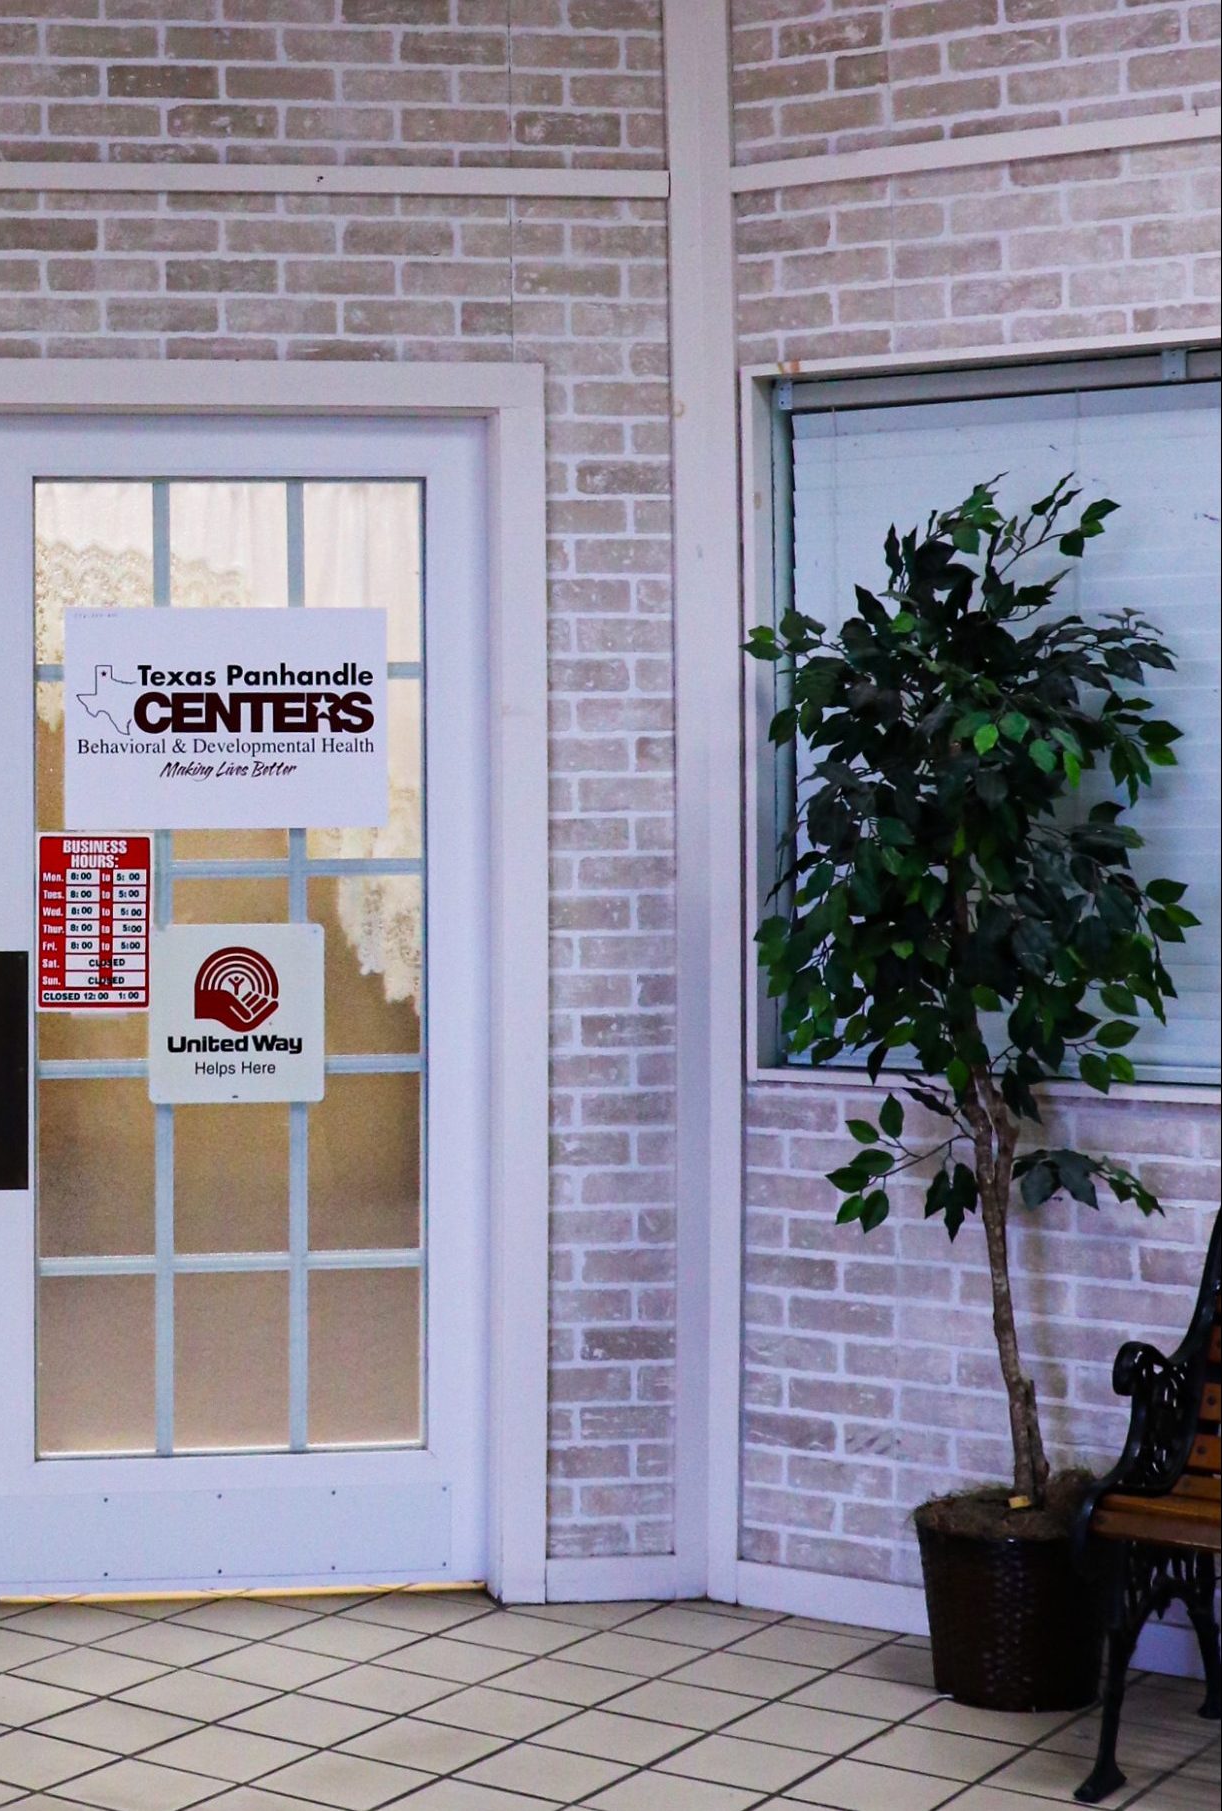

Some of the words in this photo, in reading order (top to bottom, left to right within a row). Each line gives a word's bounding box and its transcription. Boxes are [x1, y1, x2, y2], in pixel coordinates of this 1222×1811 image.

[137, 665, 216, 686] Texas
[227, 663, 374, 686] Panhandle
[134, 691, 375, 734] CENTERS
[78, 739, 166, 754] Behavioral
[172, 739, 187, 754] &
[193, 738, 315, 757] Developmental
[321, 738, 374, 753] Health
[160, 761, 214, 782] Making
[216, 762, 248, 777] Lives
[251, 761, 297, 777] Better
[63, 840, 127, 854] BUSINESS
[71, 855, 119, 868] HOURS:
[43, 873, 64, 882] Mon.
[101, 873, 110, 881] to
[43, 890, 64, 899] Tues.
[101, 890, 110, 898] to
[43, 907, 64, 916] Wed.
[101, 907, 110, 916] to
[43, 924, 65, 934] Thur.
[101, 925, 110, 934] to
[43, 942, 58, 951] Fri.
[101, 942, 110, 951] to
[42, 959, 60, 968] Sat.
[88, 958, 125, 967] CLOSED
[42, 976, 61, 985] Sun.
[88, 976, 125, 985] CLOSED
[43, 992, 80, 1001] CLOSED
[167, 1035, 248, 1053] United
[252, 1035, 303, 1055] Way
[195, 1061, 236, 1077] Helps
[242, 1061, 276, 1075] Here
